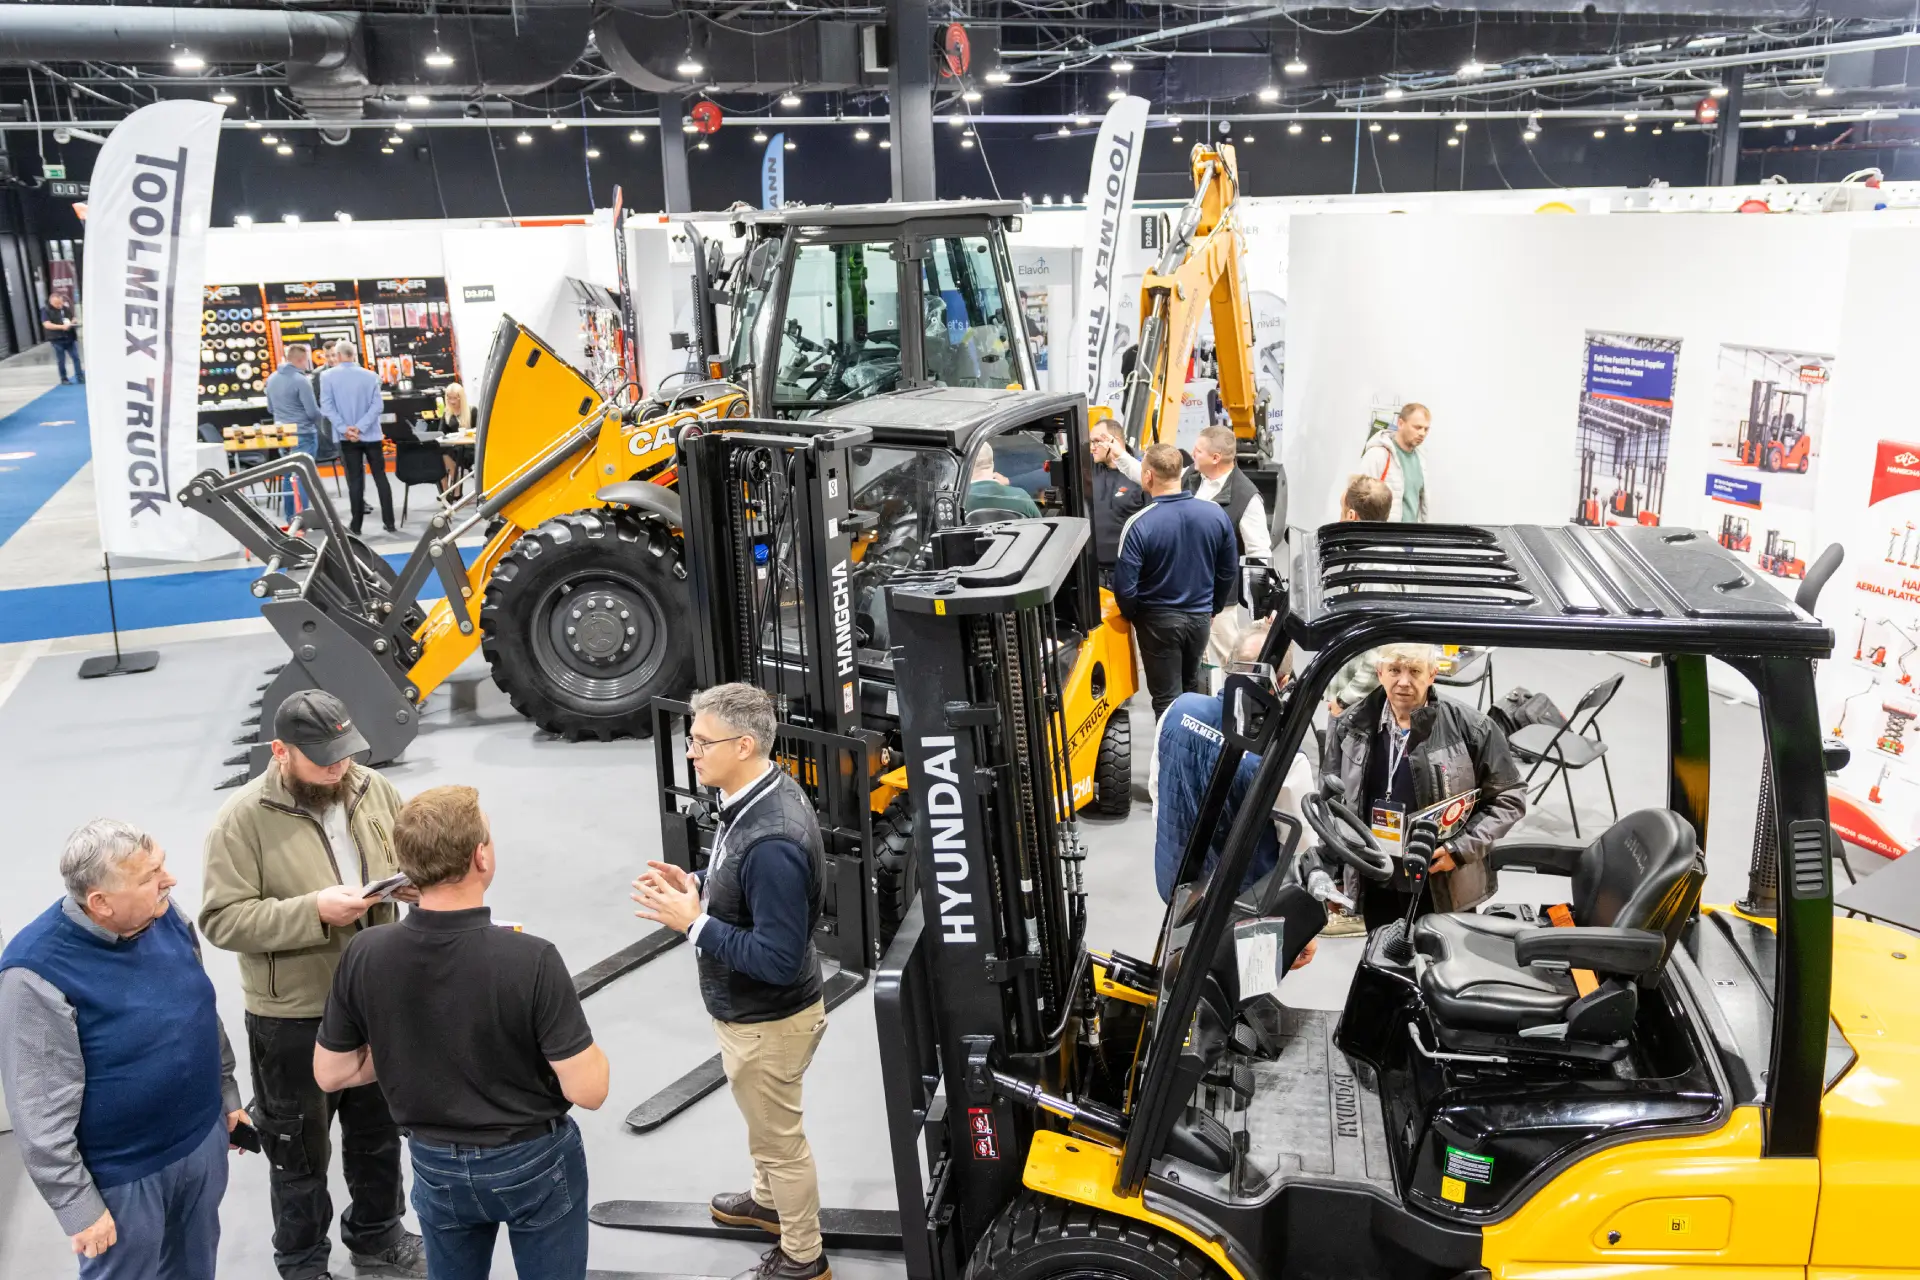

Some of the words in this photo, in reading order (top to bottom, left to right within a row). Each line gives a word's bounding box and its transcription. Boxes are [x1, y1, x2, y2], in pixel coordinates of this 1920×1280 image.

[768, 157, 778, 209] ANN
[1093, 130, 1133, 293] TOOLMEX
[124, 147, 187, 360] TOOLMEX
[1018, 264, 1050, 276] Elavon
[203, 284, 241, 300] EXER
[284, 280, 336, 297] REXER
[376, 277, 426, 294] REXER
[125, 377, 172, 518] TRUCK
[1886, 466, 1920, 478] HANGCHA
[1855, 580, 1886, 595] AERIAL
[1887, 588, 1920, 604] PLATFO
[832, 559, 853, 677] HANGCHA
[1079, 698, 1110, 738] TRUCK
[1181, 713, 1220, 743] TOOLMEX
[926, 736, 977, 944] HYUNDAI
[1857, 833, 1878, 846] GROUP
[1333, 1069, 1358, 1139] HYUNDAI
